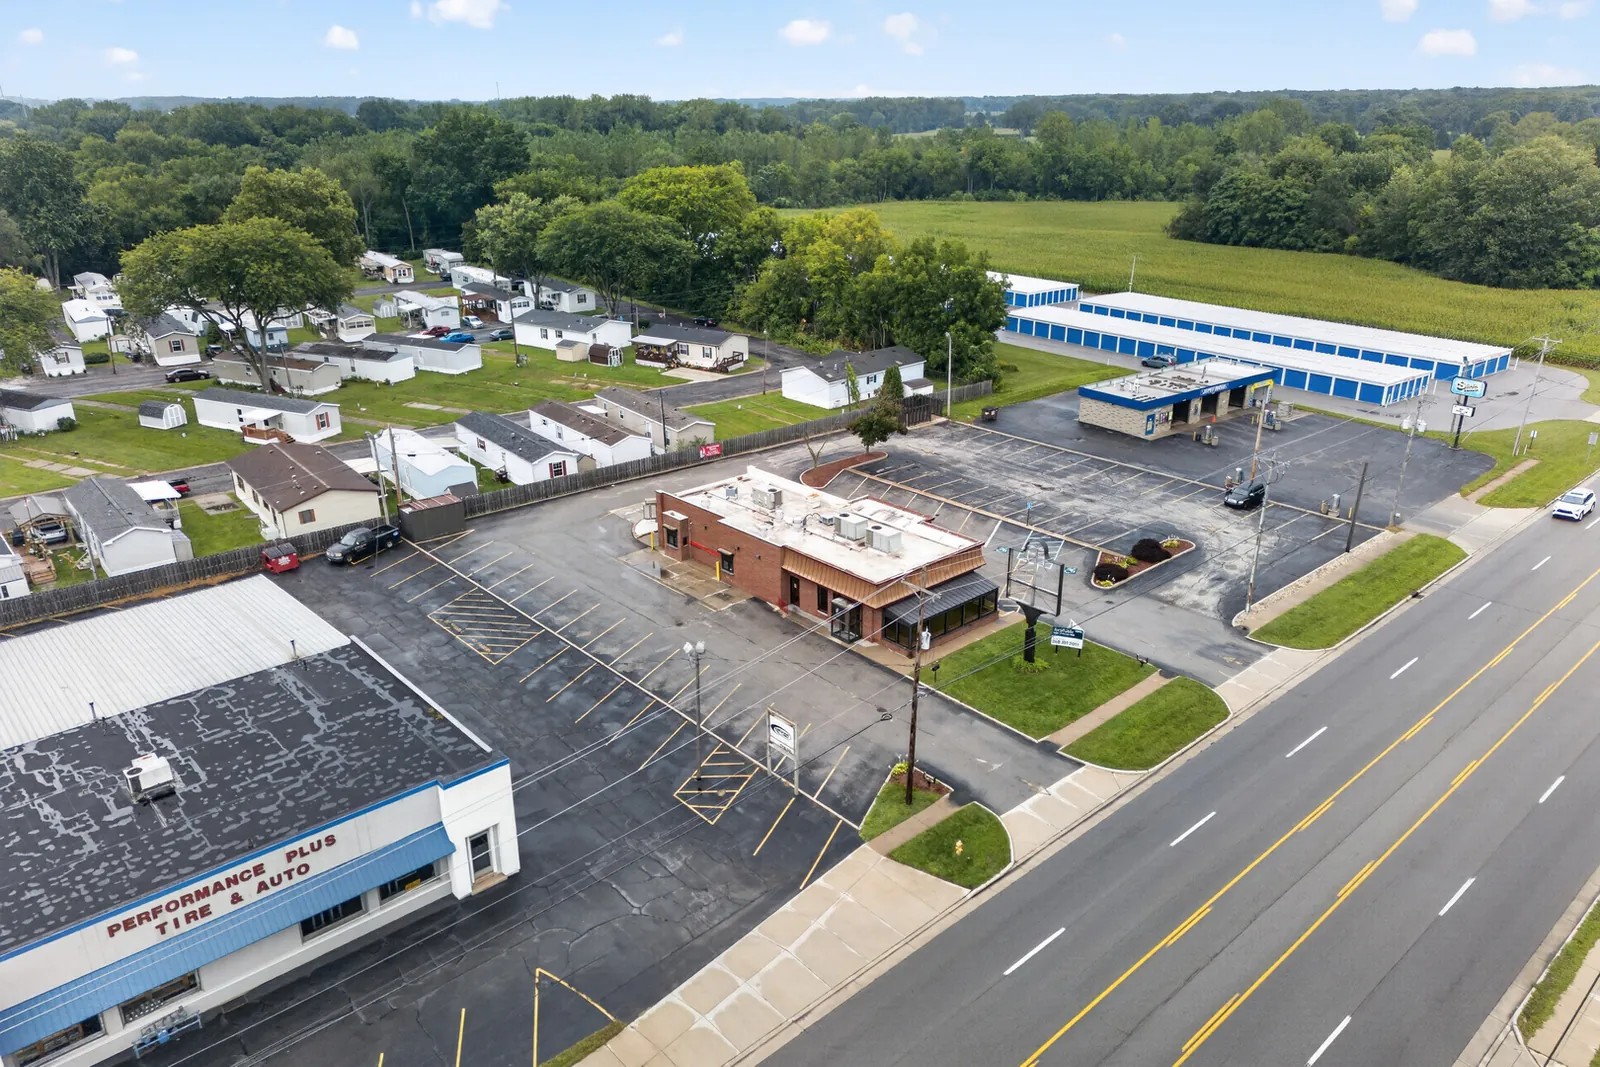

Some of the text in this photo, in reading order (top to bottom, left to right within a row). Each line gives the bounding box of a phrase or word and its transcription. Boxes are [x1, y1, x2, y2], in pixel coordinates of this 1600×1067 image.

[107, 834, 337, 938] PERFORMANCE PLUS
[155, 863, 311, 935] TIRE & AUTO
